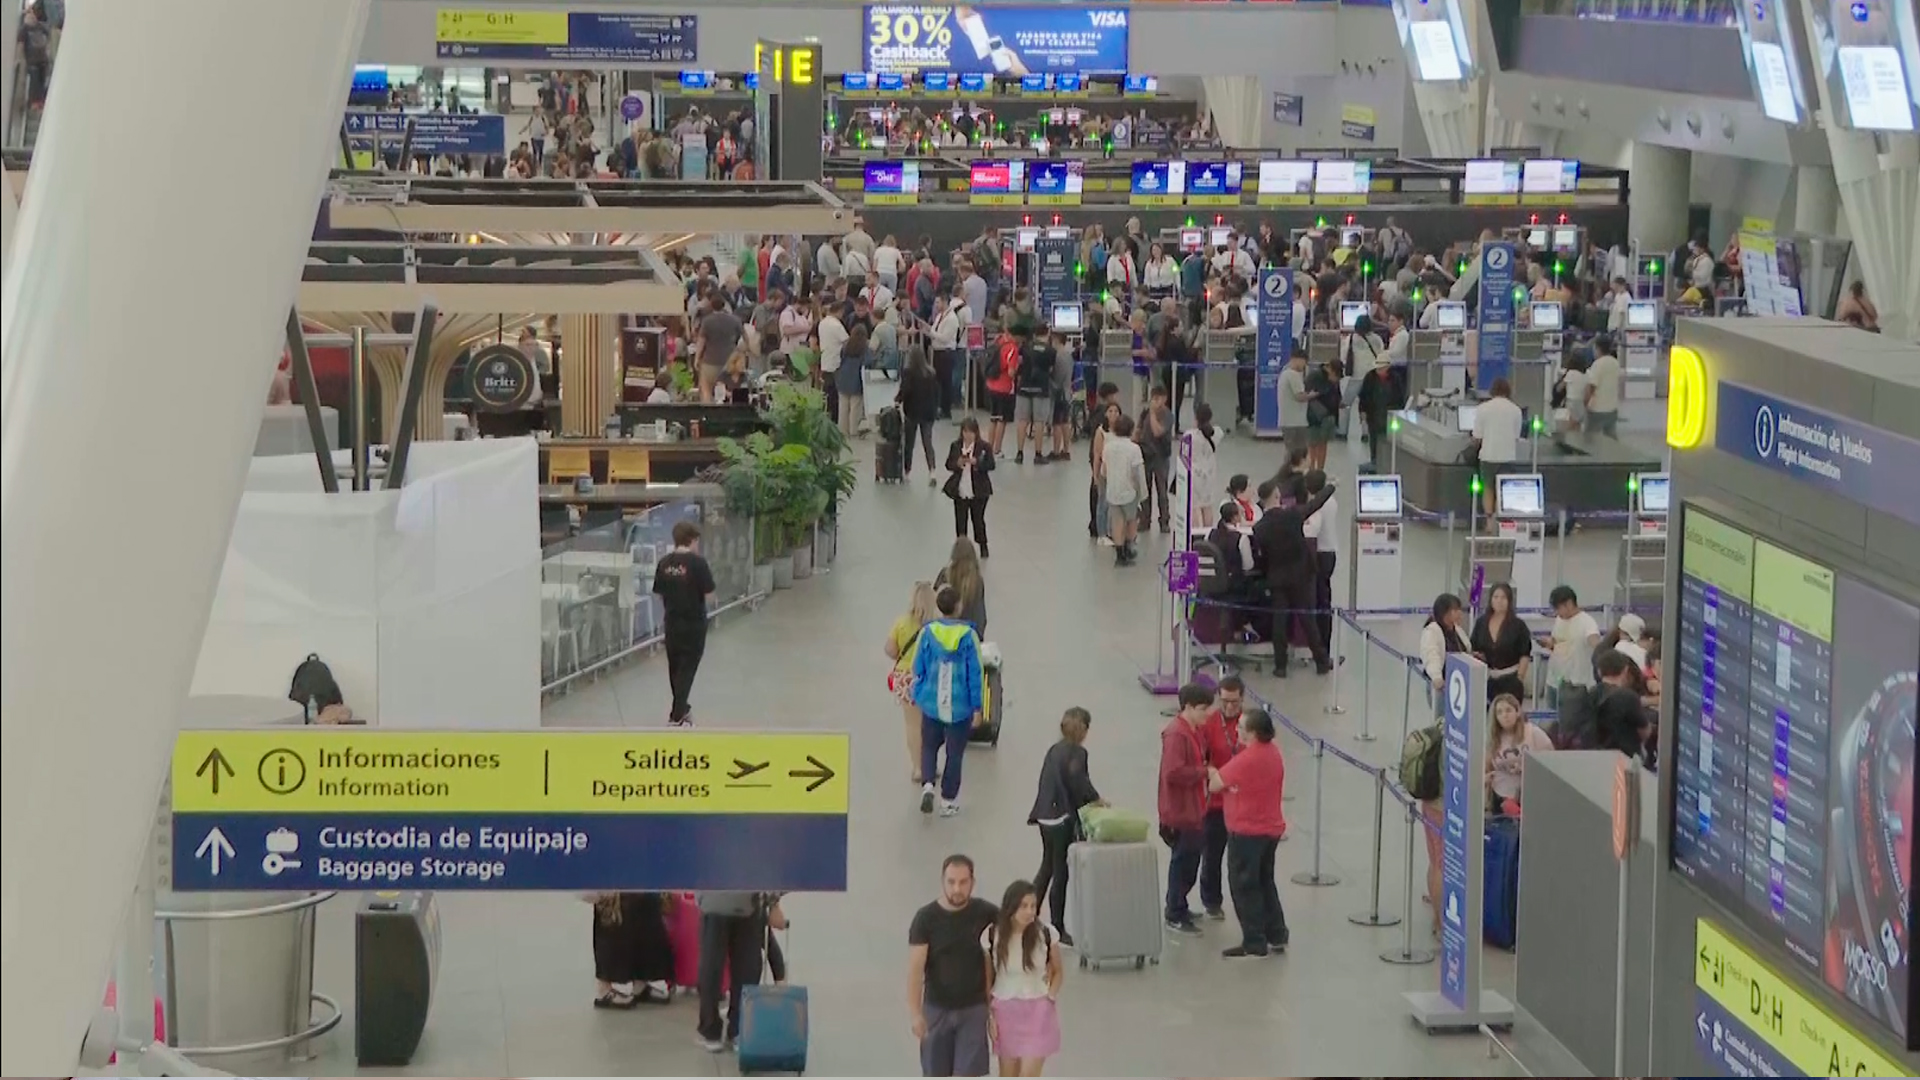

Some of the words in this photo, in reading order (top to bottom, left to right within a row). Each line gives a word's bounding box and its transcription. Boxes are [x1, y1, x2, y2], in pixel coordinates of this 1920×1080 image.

[870, 15, 952, 45] 30%
[1087, 10, 1126, 27] VISA
[792, 49, 813, 82] E
[1493, 252, 1503, 266] 2
[1270, 278, 1282, 294] 2
[1271, 329, 1280, 338] A
[1667, 345, 1706, 448] D
[1778, 413, 1828, 449] Información
[1828, 429, 1841, 453] de
[1841, 434, 1872, 465] Vuelos
[1778, 442, 1798, 466] Flight
[1798, 449, 1841, 481] Information
[318, 747, 501, 769] Informaciones
[624, 749, 710, 770] Salidas
[318, 778, 450, 797] Information
[592, 780, 710, 801] Departures
[318, 827, 433, 849] Custodia
[439, 826, 471, 849] de
[479, 826, 589, 855] Equipaje
[318, 857, 415, 881] Baggage
[420, 857, 506, 881] Storage
[1750, 979, 1761, 1015] D
[1772, 995, 1783, 1036] H
[1828, 1042, 1841, 1077] A
